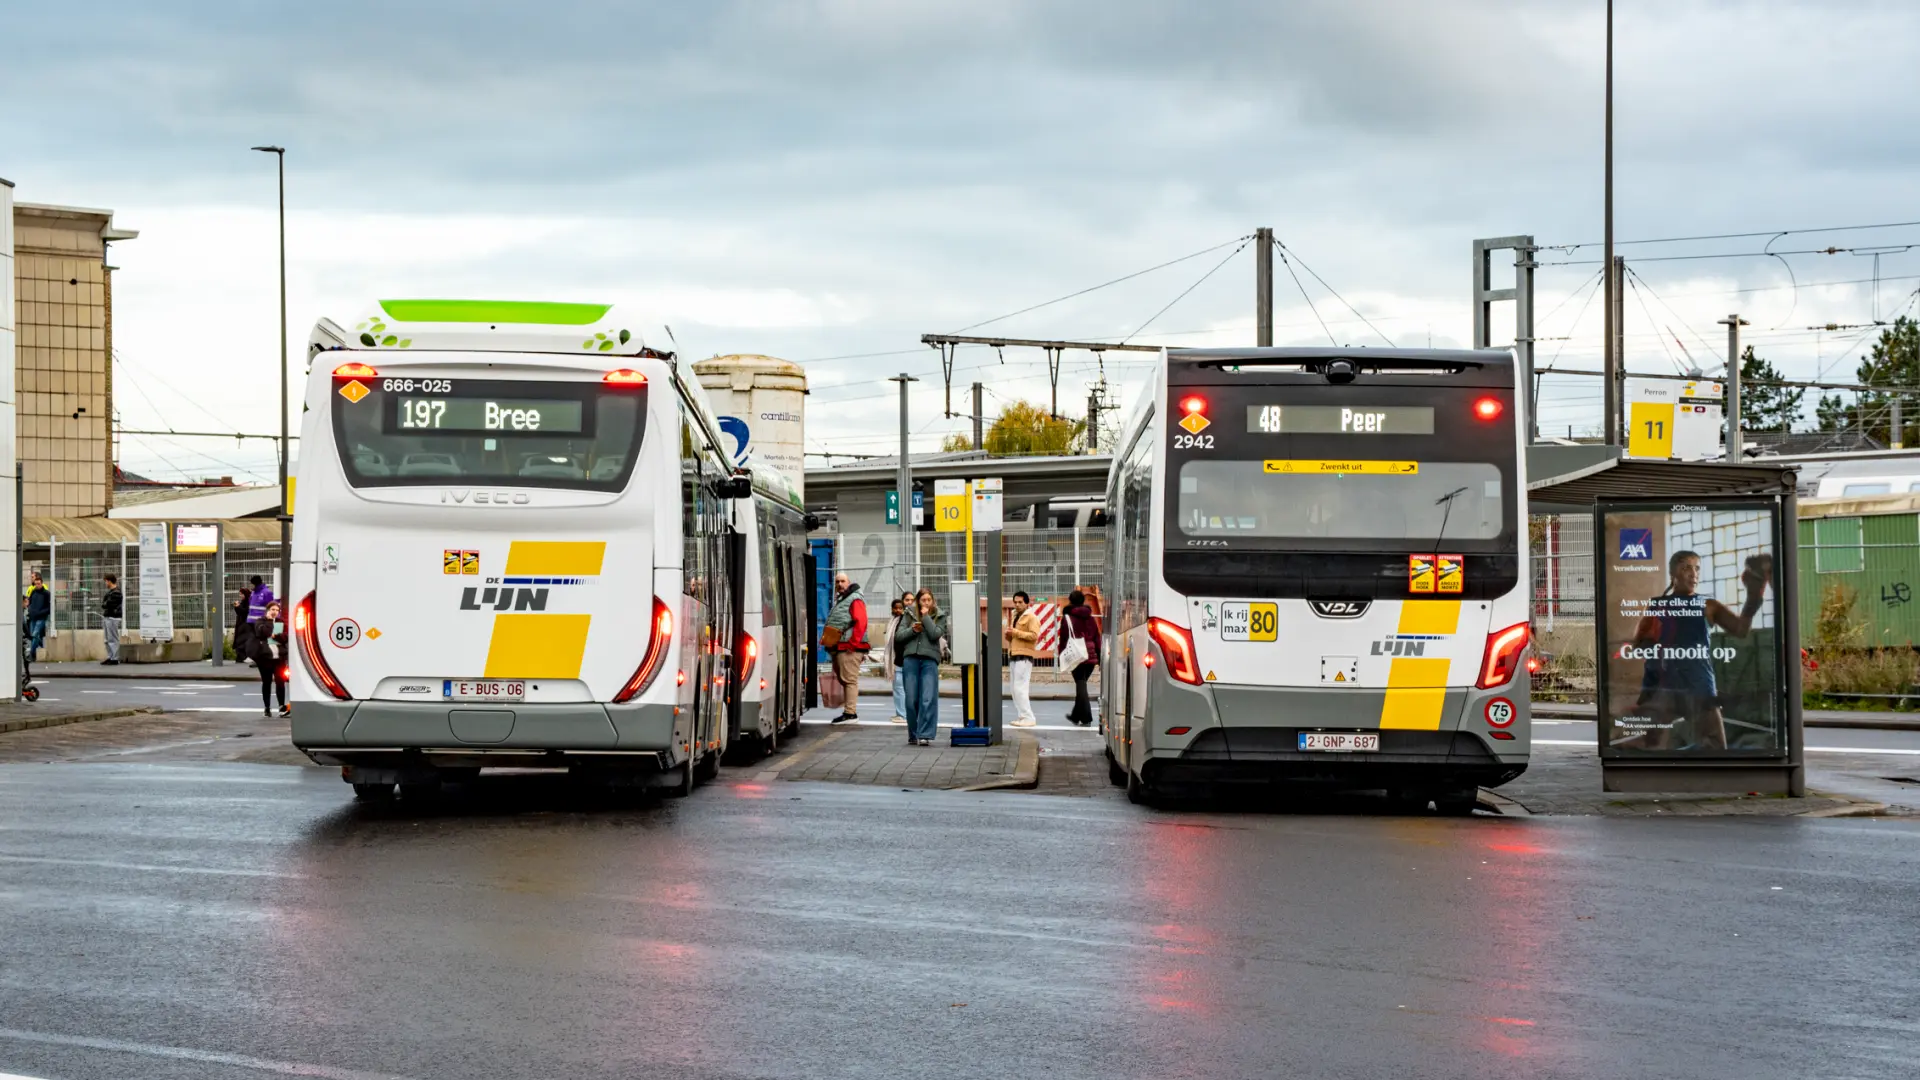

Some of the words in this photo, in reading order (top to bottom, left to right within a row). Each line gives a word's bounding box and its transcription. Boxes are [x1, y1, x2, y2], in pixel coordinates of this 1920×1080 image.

[383, 379, 452, 393] 666-025
[1644, 388, 1667, 396] Perron
[402, 400, 446, 428] 197
[485, 402, 541, 430] Bree
[1259, 405, 1281, 432] 48
[1341, 408, 1386, 432] Peer
[1645, 420, 1663, 440] 11
[1174, 435, 1215, 449] 2942
[1320, 462, 1349, 471] Zwenkt
[1351, 463, 1362, 471] uit
[441, 491, 531, 505] IVECO
[942, 506, 959, 519] 10
[1670, 504, 1707, 512] JCDecaux
[1620, 544, 1647, 557] AXA
[460, 587, 549, 611] LIJN
[1620, 598, 1639, 606] Aan
[1641, 598, 1657, 606] wie
[1669, 598, 1688, 606] elke
[1689, 598, 1707, 608] dag
[1319, 602, 1359, 613] VDL
[1643, 609, 1666, 617] moet
[1667, 608, 1703, 617] vechten
[1224, 610, 1233, 619] Ik
[1236, 610, 1248, 622] rij
[1250, 611, 1275, 633] 80
[335, 626, 354, 641] 85
[1370, 641, 1425, 656] LIJN
[1620, 643, 1662, 659] Geef
[1663, 643, 1709, 659] nooit
[1712, 647, 1737, 663] op
[1492, 704, 1509, 717] 75
